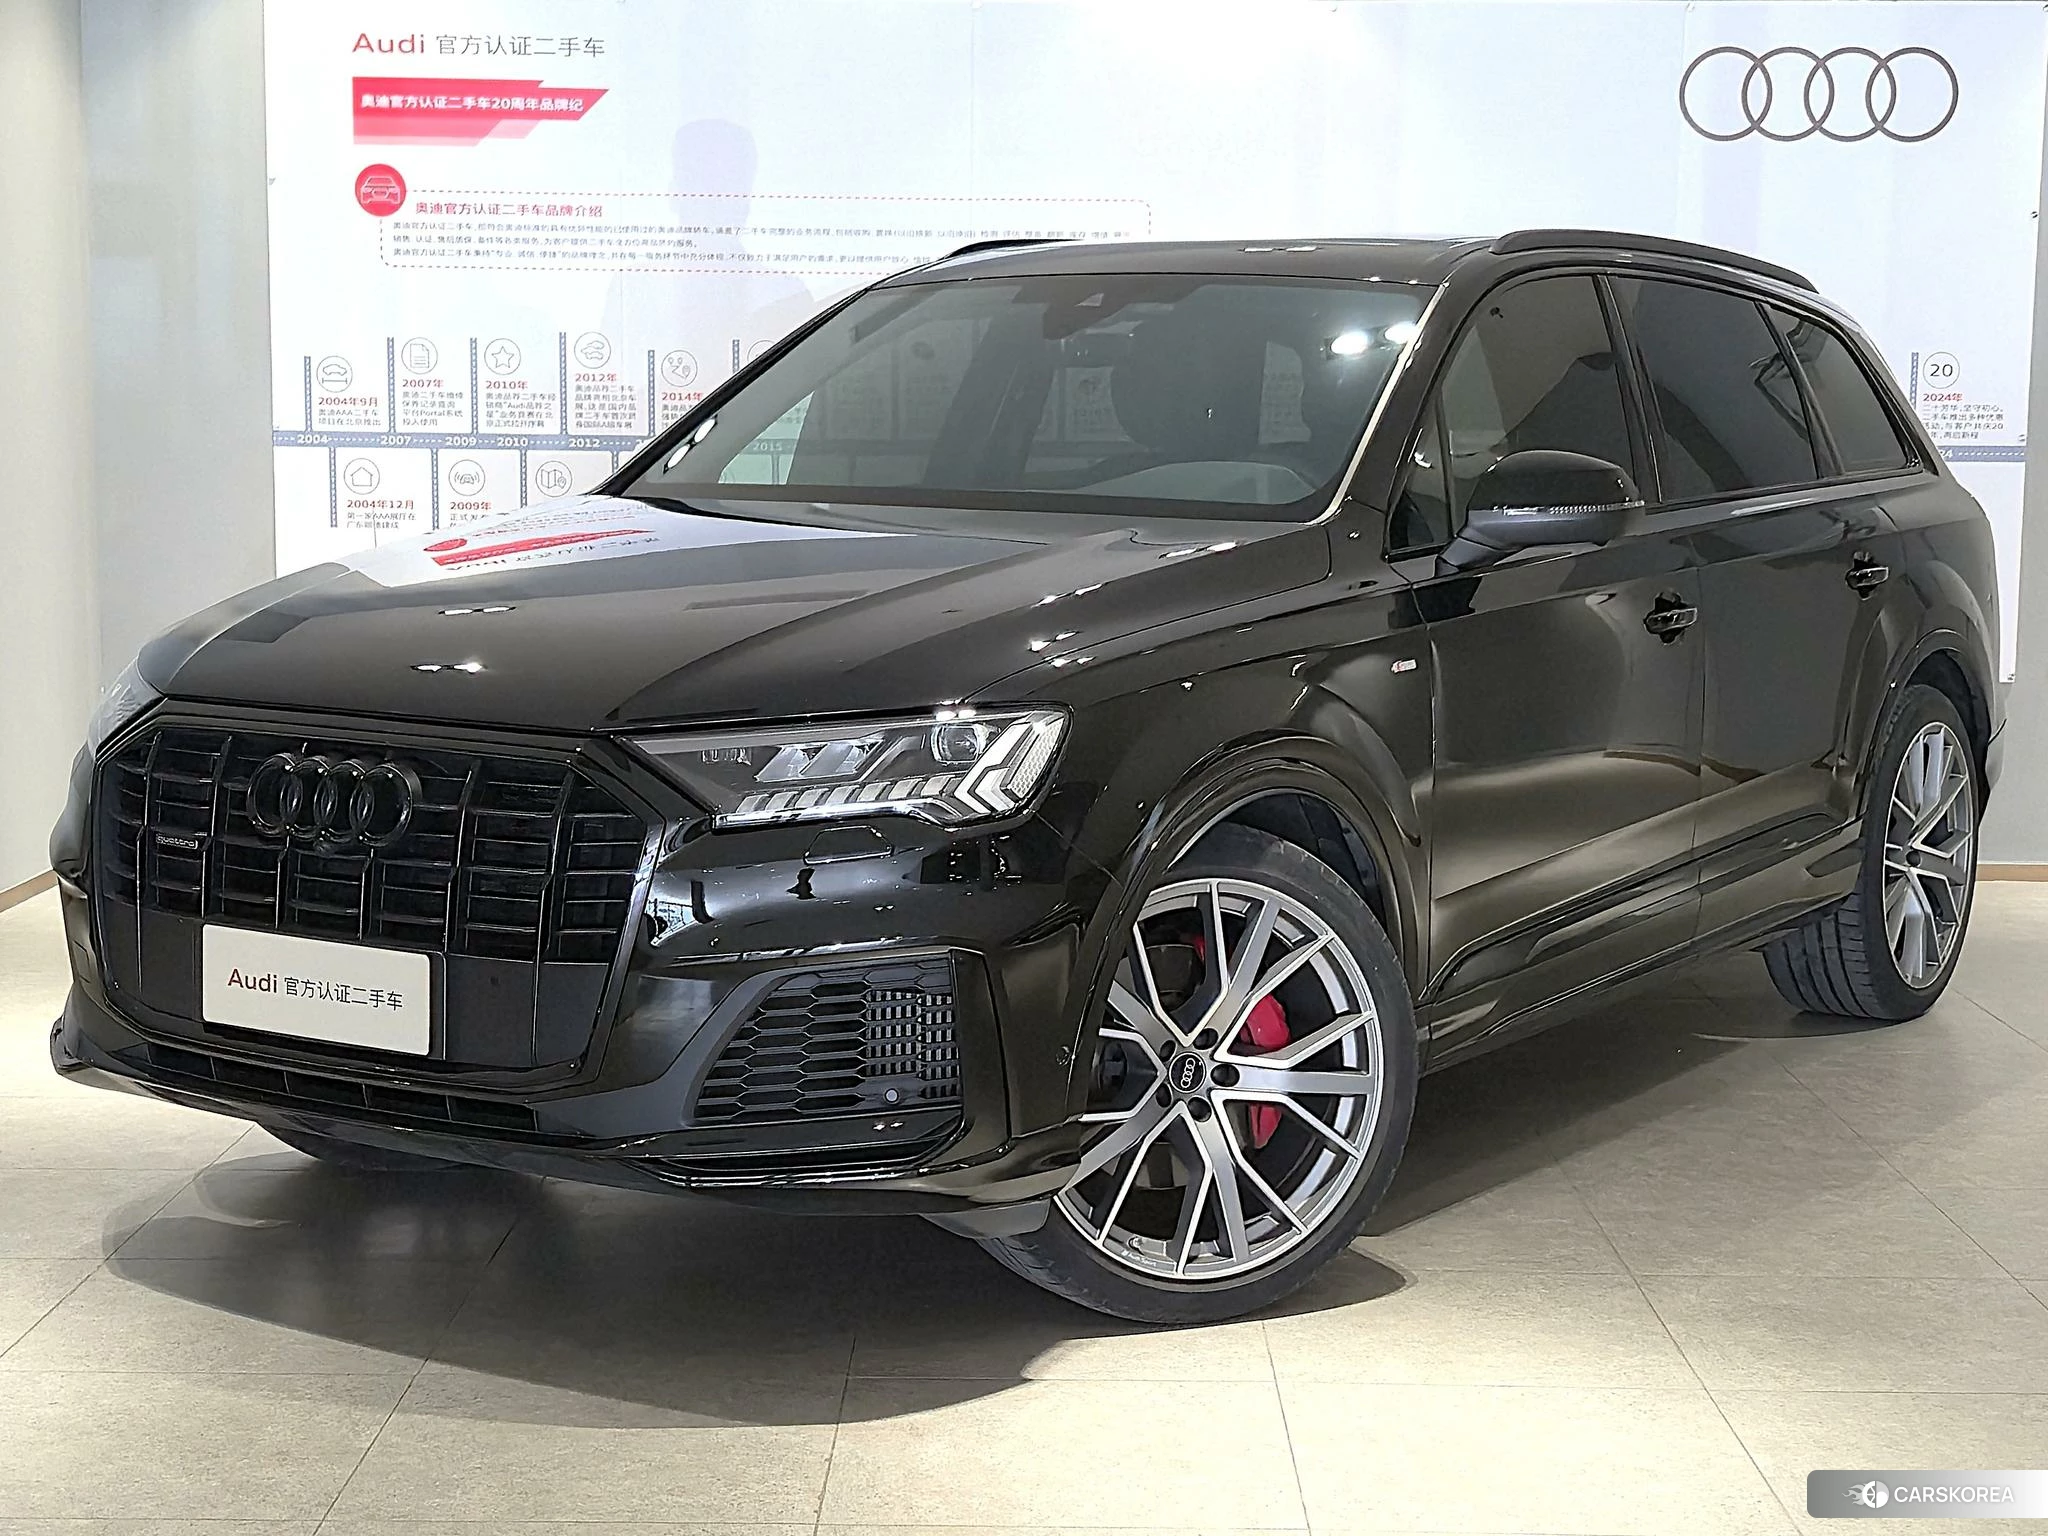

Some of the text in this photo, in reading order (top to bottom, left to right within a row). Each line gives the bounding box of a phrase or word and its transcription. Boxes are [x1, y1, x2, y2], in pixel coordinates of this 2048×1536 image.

[352, 33, 605, 58] Audi 官方认证二手车
[415, 202, 603, 218] 奥迪官方认证二手车品牌介绍
[1930, 363, 1953, 377] 20
[575, 373, 617, 382] 2012年
[402, 379, 444, 388] 2007年
[485, 380, 528, 390] 2010年
[318, 396, 378, 407] 2004年9月
[662, 392, 702, 401] 2014年
[1923, 393, 1963, 402] 2024年
[297, 434, 329, 444] 2004
[380, 435, 411, 445] 2007
[445, 437, 477, 446] 2009
[497, 437, 529, 447] 2010
[569, 438, 600, 448] 2012
[753, 443, 783, 452] 2015
[347, 499, 414, 510] 2004年12月
[450, 501, 492, 511] 2009年
[157, 836, 195, 847] quattro
[228, 968, 403, 1011] Audi 官方认证二手车
